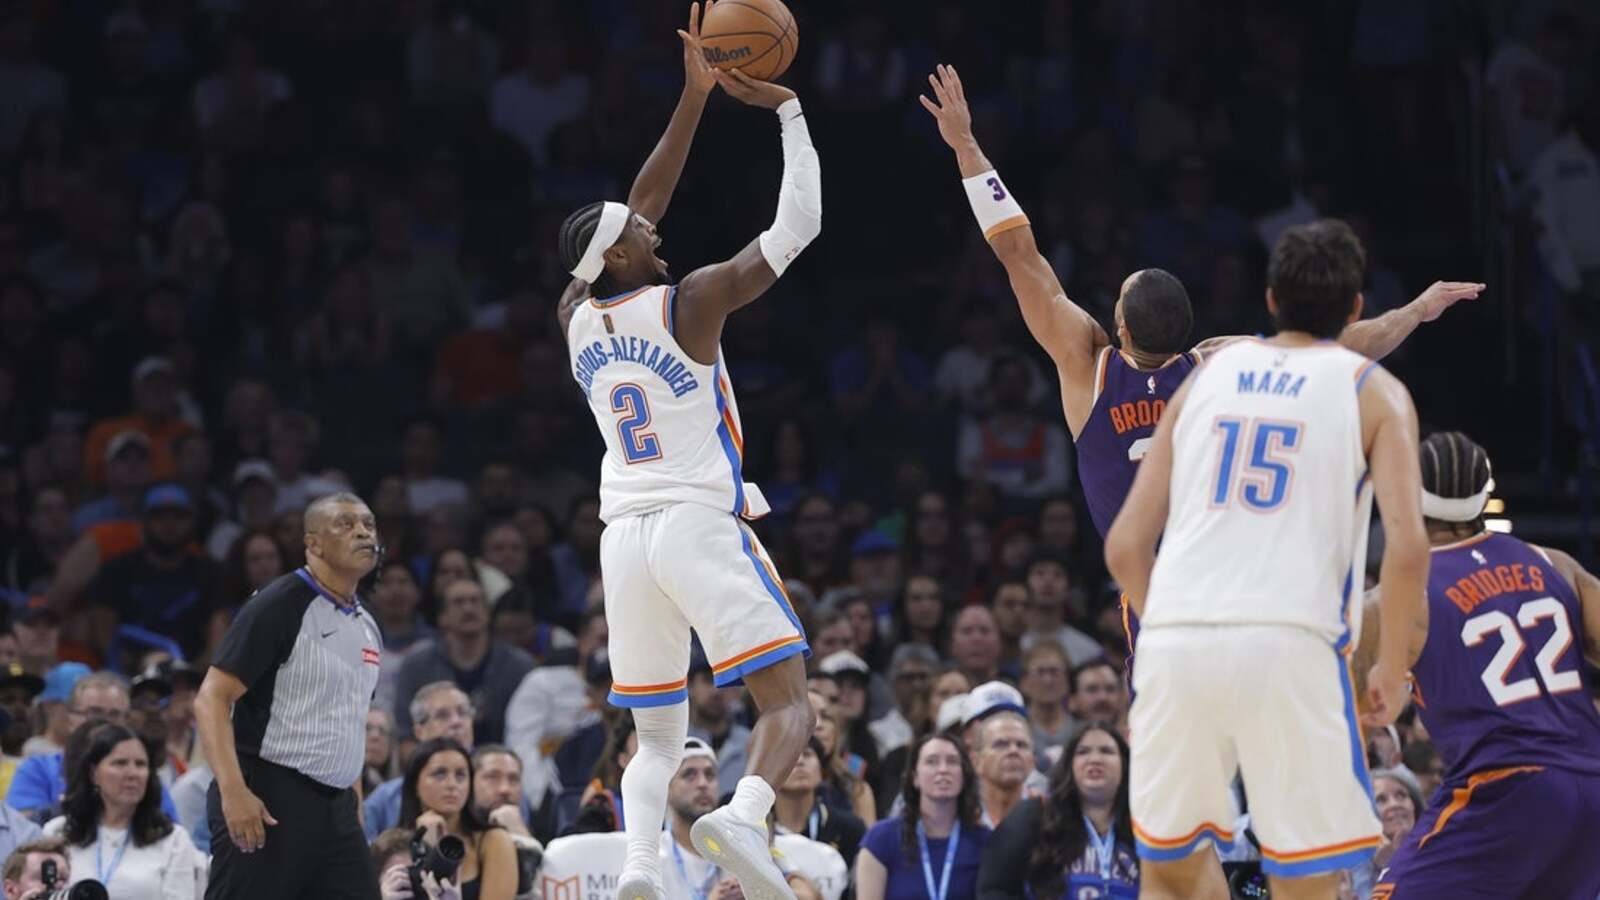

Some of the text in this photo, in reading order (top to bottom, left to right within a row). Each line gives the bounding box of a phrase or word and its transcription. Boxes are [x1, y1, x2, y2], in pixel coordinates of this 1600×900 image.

[986, 177, 1006, 201] 3
[575, 335, 699, 399] GEOUS-ALEXANDER
[1237, 370, 1307, 397] MARA
[609, 382, 663, 465] 2
[1207, 414, 1306, 515] 15
[1445, 564, 1545, 614] BRIDGES
[1460, 597, 1584, 707] 22
